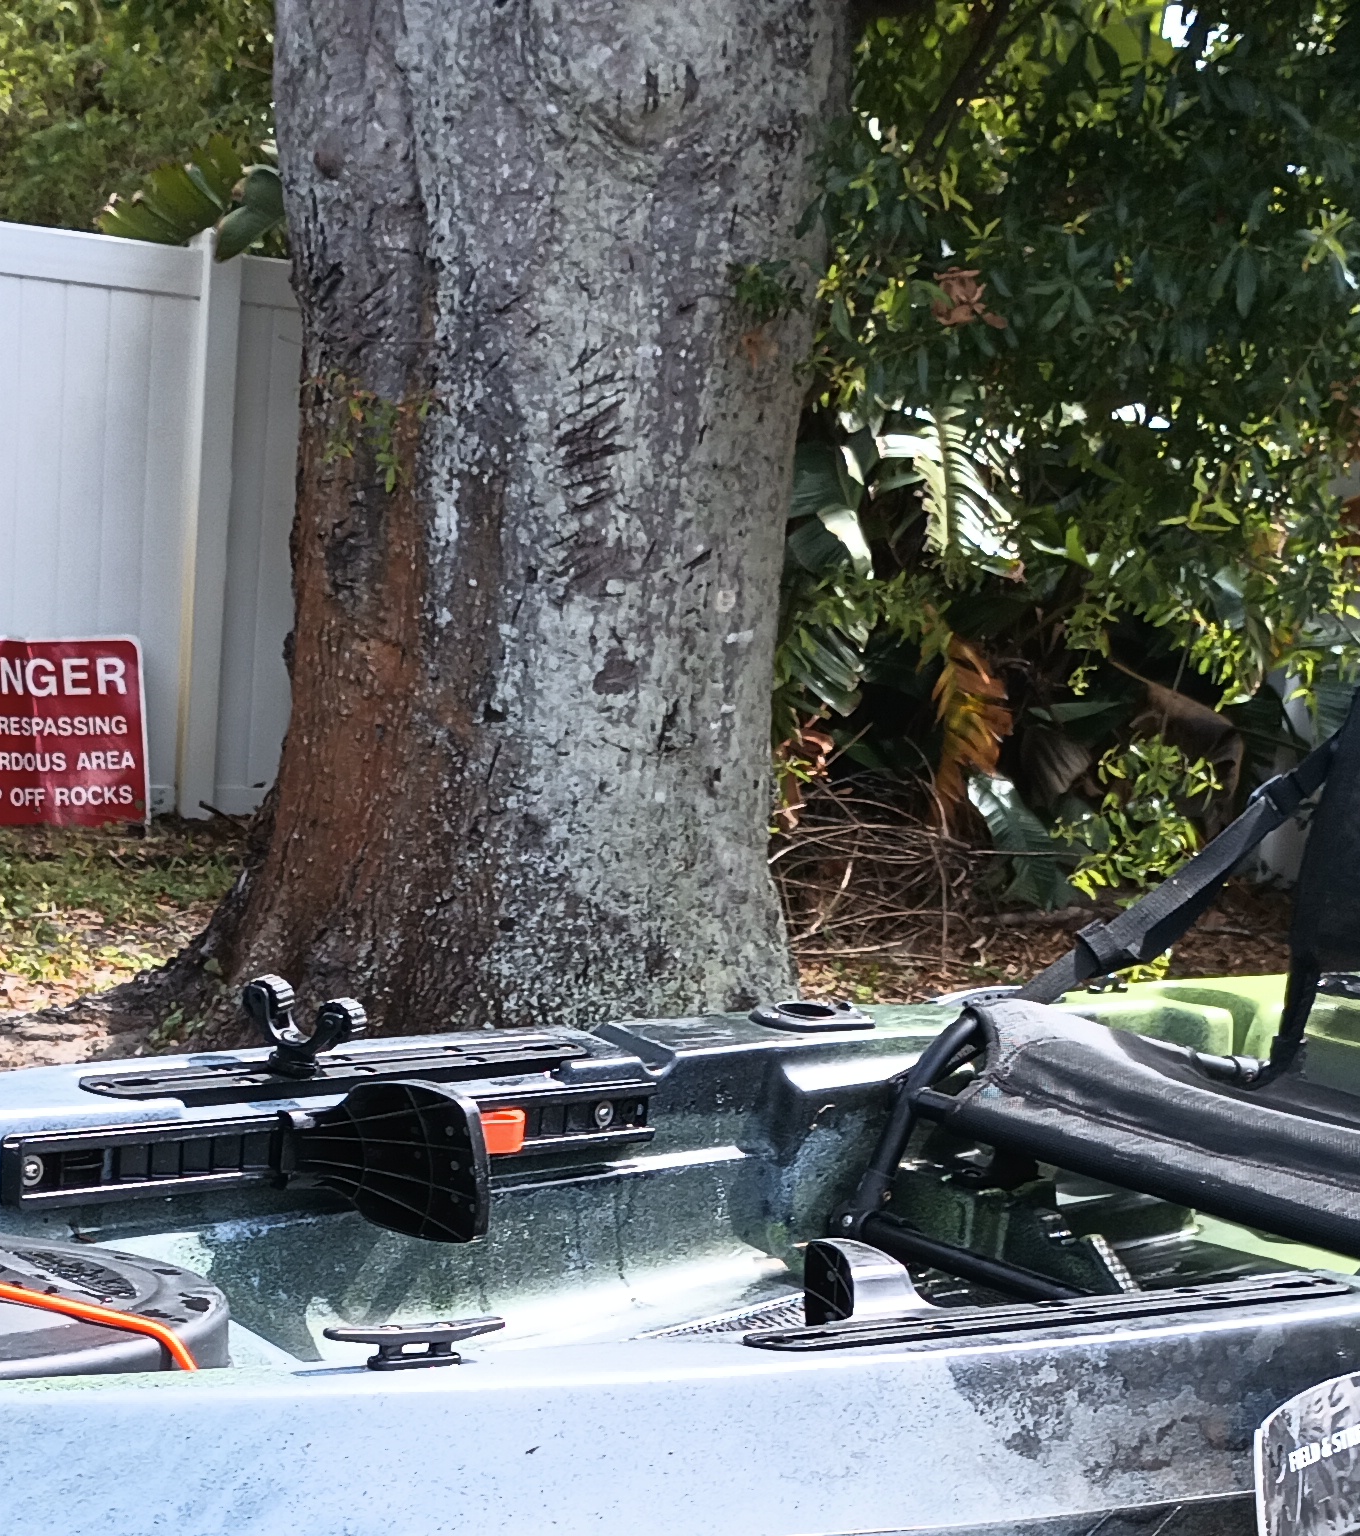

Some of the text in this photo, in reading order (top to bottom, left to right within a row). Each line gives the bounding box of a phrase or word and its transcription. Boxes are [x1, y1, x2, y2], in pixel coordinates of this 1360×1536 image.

[76, 750, 136, 771] AREA
[10, 787, 45, 807] OFF
[54, 784, 133, 807] ROCKS
